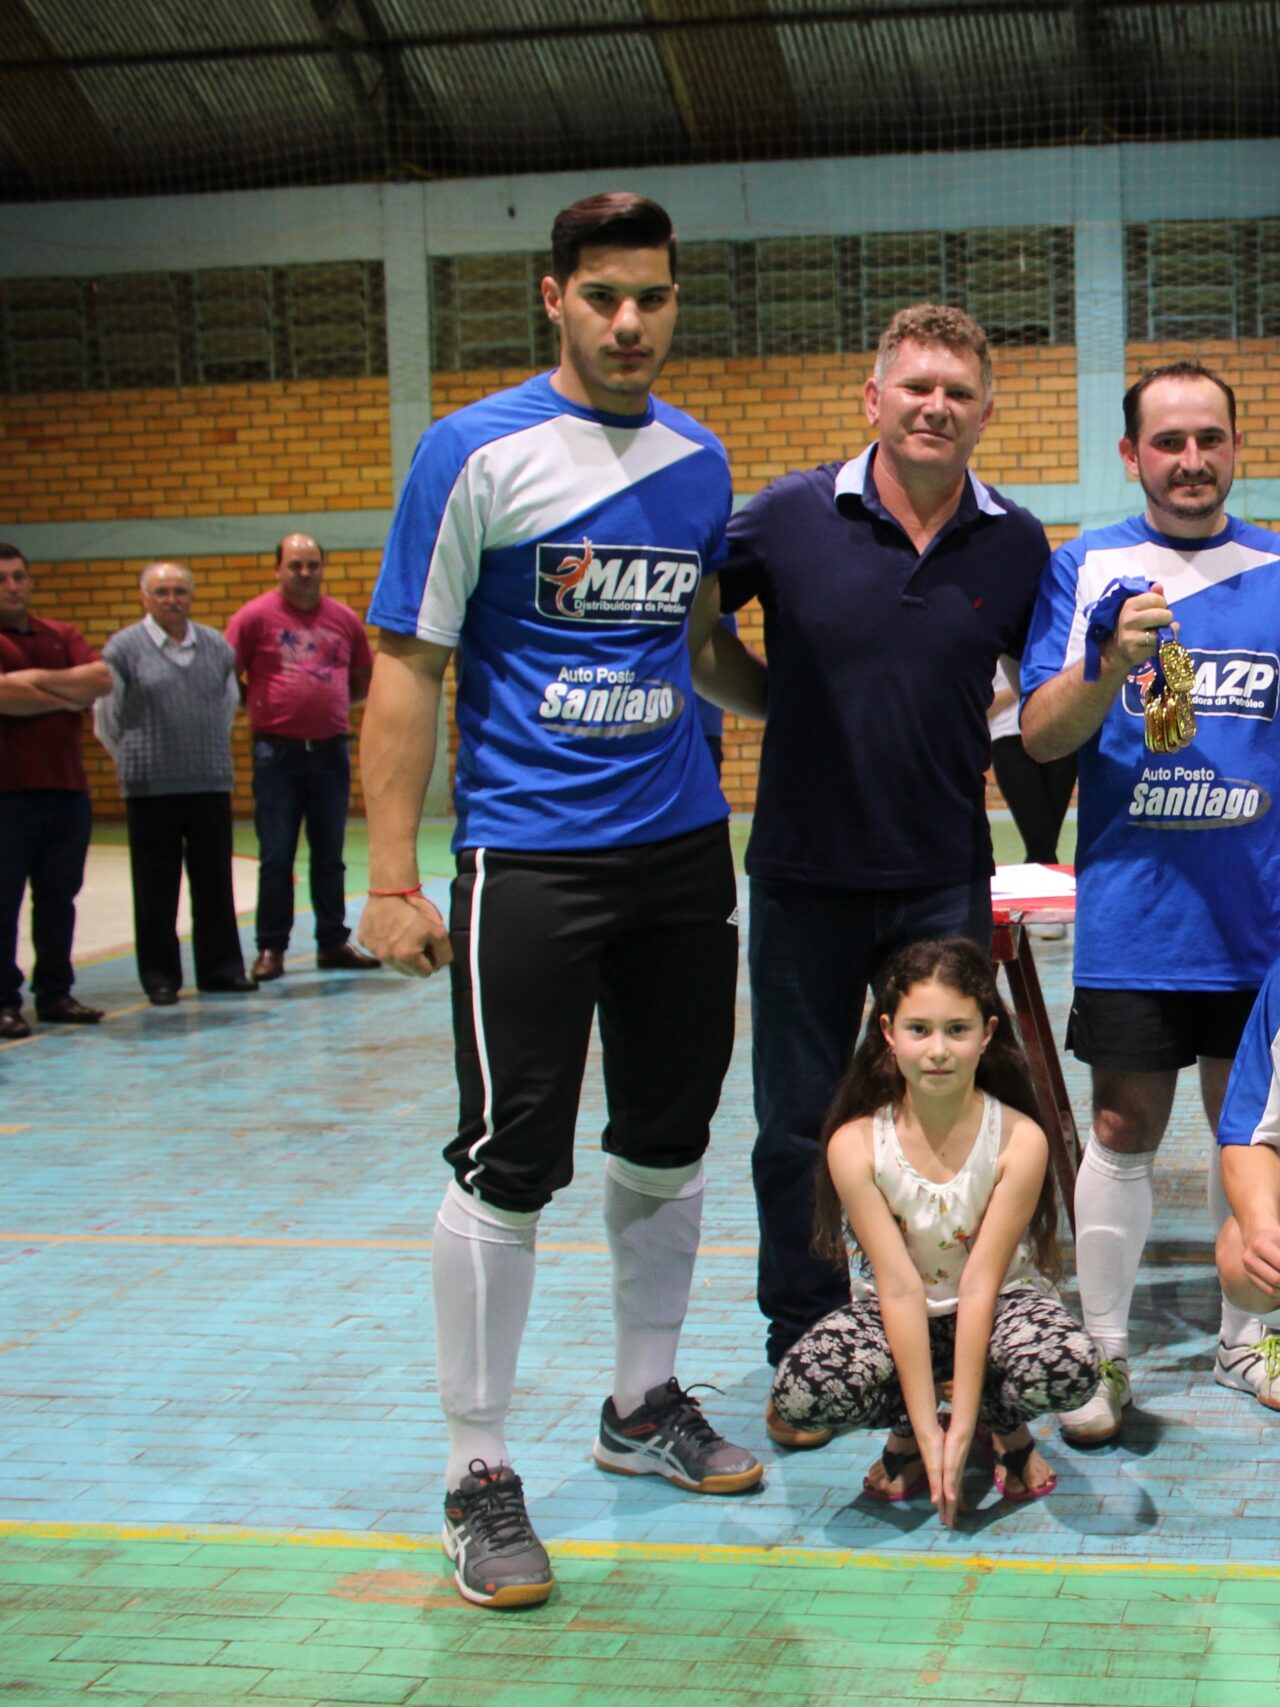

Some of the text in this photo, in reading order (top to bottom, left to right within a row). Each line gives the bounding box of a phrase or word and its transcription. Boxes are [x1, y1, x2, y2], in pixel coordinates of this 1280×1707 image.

[572, 558, 698, 602] MAZP
[574, 600, 643, 611] Distribuidora
[644, 602, 656, 612] de
[557, 667, 635, 684] Auto Posto
[1190, 660, 1275, 698] AZP
[539, 682, 674, 723] Santiago
[1214, 697, 1226, 706] de
[1142, 767, 1215, 782] Auto Posto
[1129, 783, 1259, 820] Santiago
